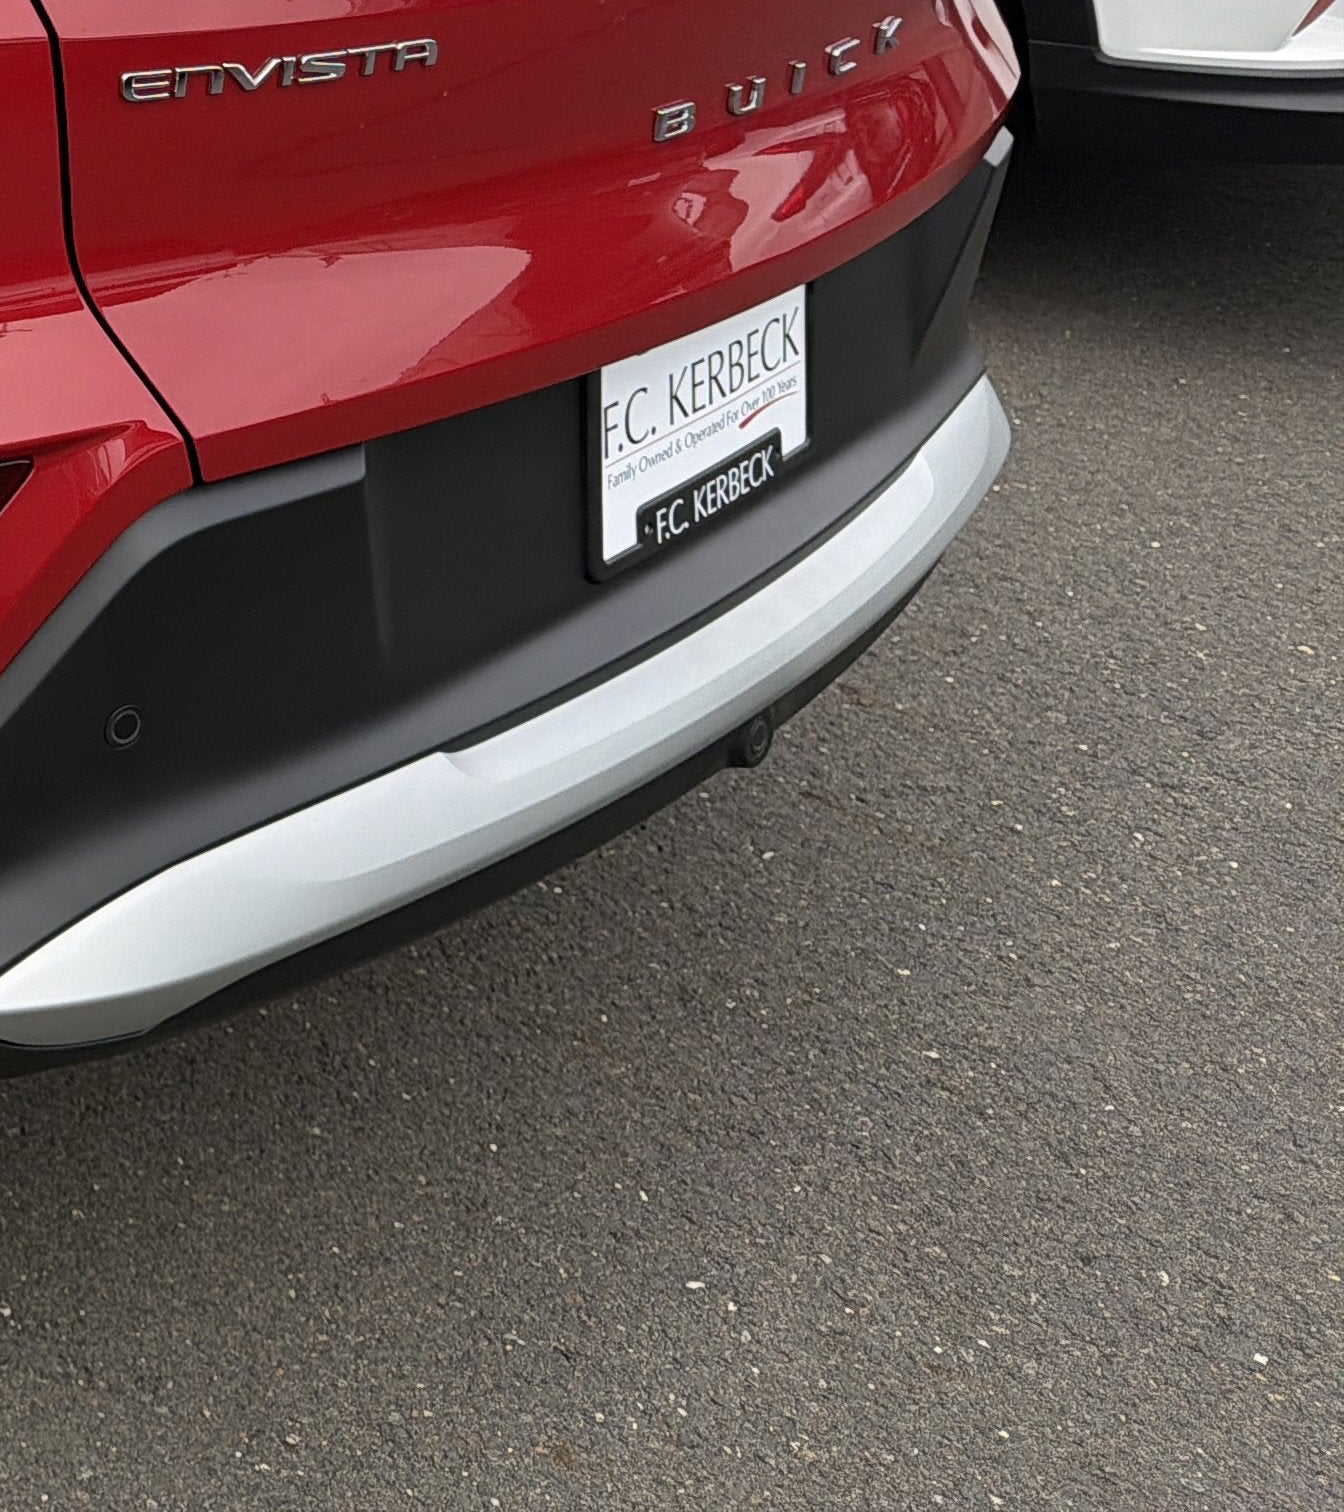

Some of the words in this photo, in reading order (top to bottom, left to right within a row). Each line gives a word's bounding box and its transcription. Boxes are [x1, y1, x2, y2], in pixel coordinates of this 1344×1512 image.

[652, 16, 903, 142] BUICK
[604, 387, 657, 460] F.C.
[668, 306, 800, 426] KERBECK
[607, 462, 637, 490] Family
[639, 441, 673, 473] Owned
[674, 438, 683, 454] &
[684, 413, 725, 449] Operated
[726, 409, 739, 426] For
[741, 397, 760, 417] Over
[656, 498, 690, 545] F.C.
[693, 444, 774, 523] KERBECK
